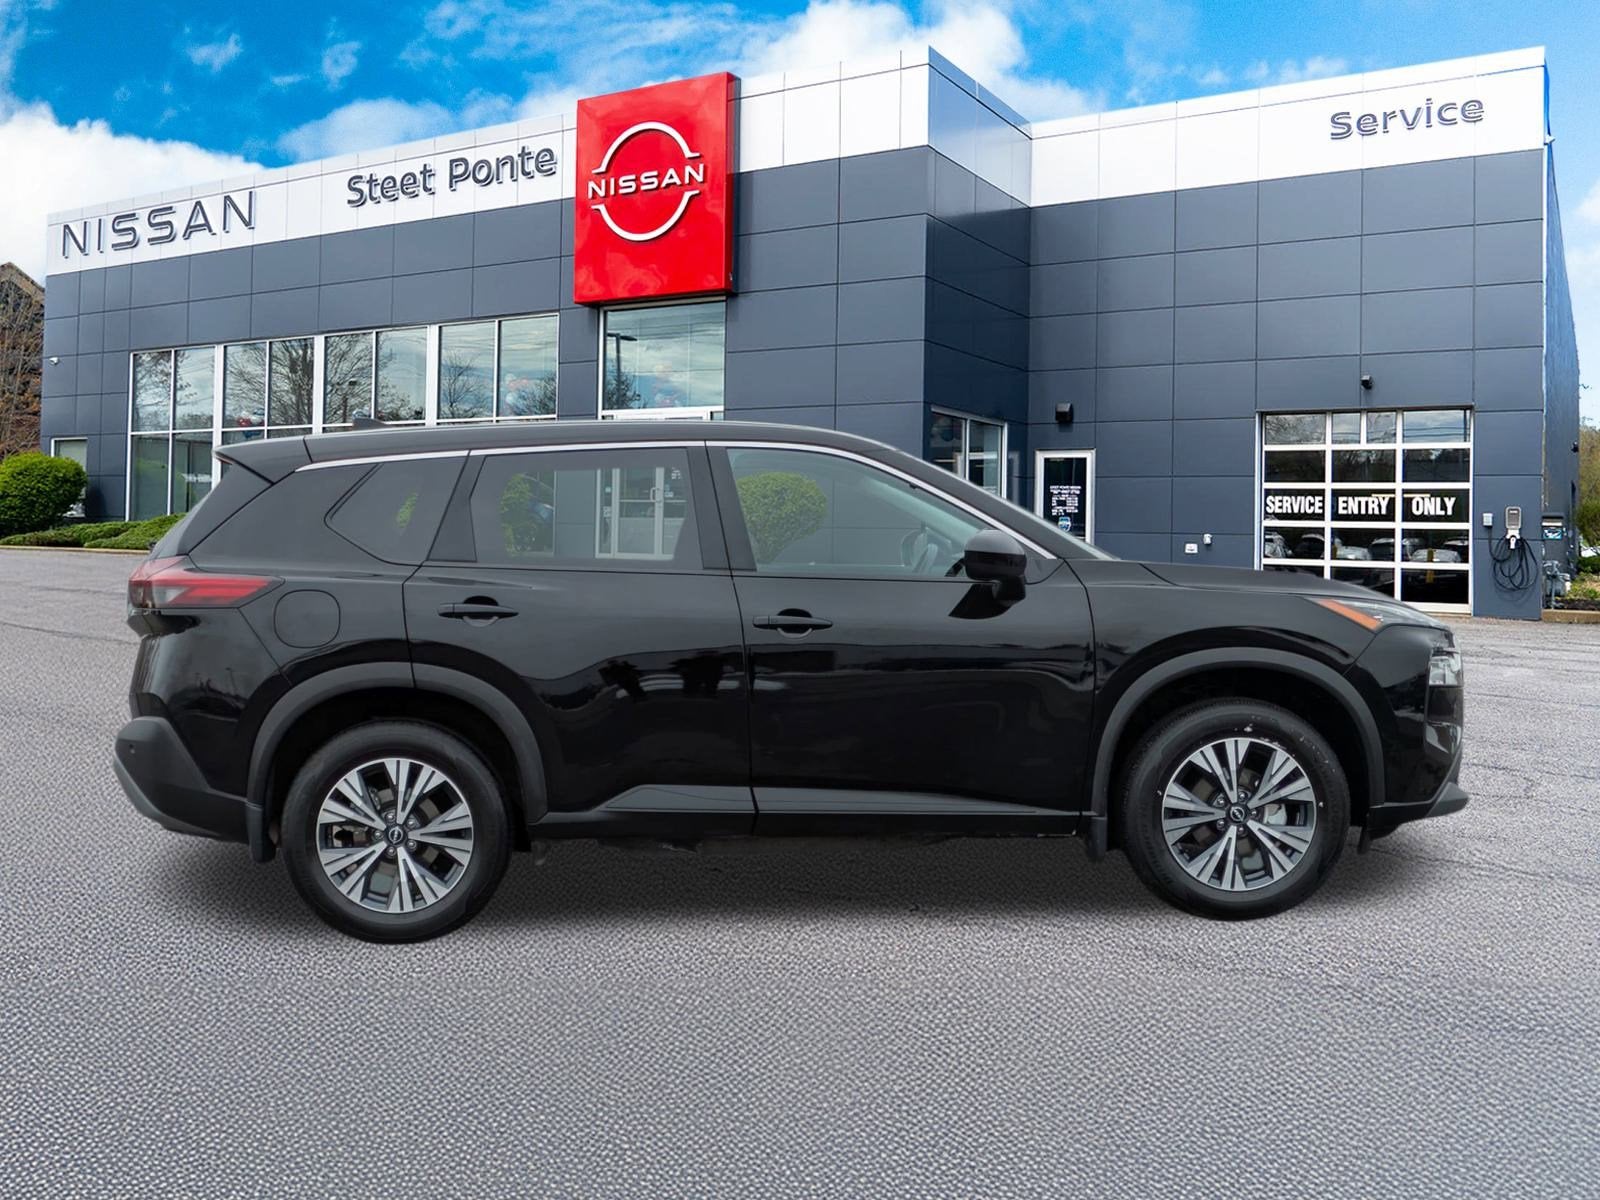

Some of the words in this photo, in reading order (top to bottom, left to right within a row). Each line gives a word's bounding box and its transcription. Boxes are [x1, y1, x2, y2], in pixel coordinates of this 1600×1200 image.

[1330, 98, 1484, 140] Service
[347, 162, 435, 206] Steet
[448, 145, 557, 191] Ponte
[588, 163, 704, 199] NISSAN
[62, 190, 255, 259] NISSAN
[1265, 495, 1324, 514] SERVICE
[1337, 496, 1390, 515] ENTRY
[1411, 496, 1457, 516] ONLY
